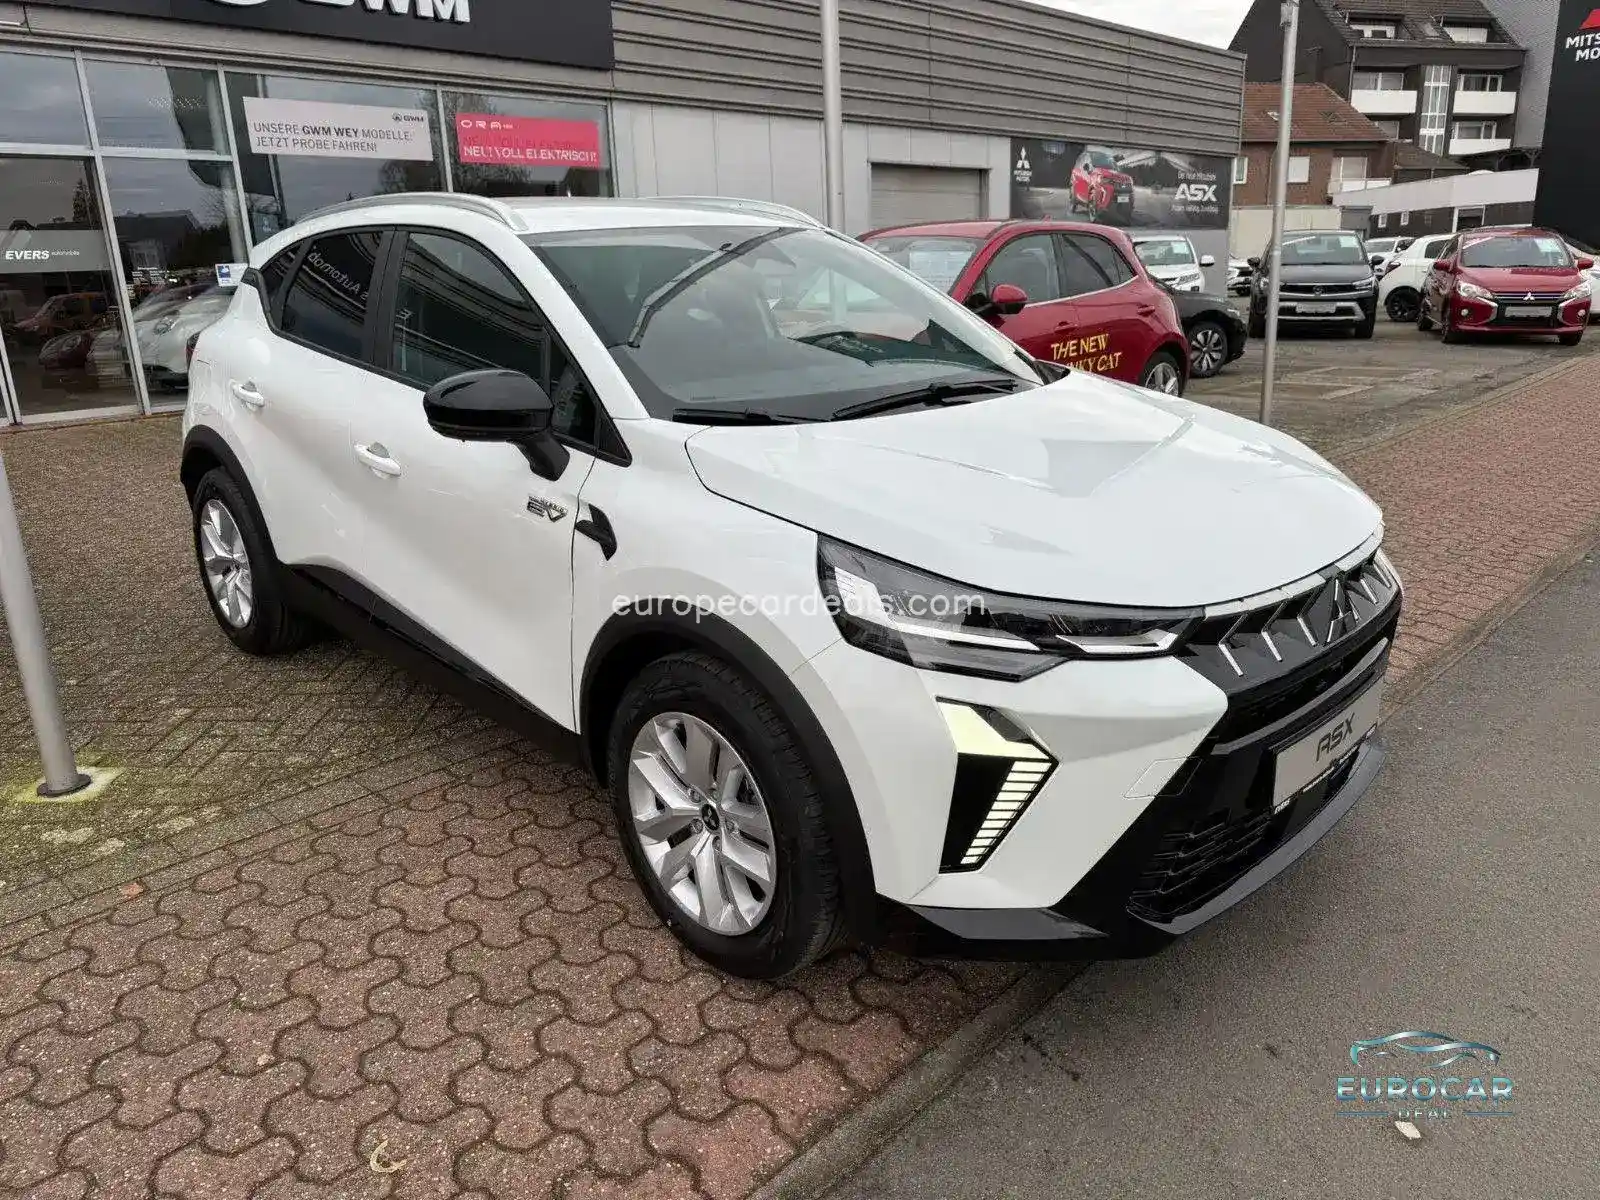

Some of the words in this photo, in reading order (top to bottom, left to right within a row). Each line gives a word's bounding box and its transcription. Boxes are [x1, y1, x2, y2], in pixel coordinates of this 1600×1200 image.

[1575, 47, 1600, 62] MO
[403, 114, 424, 123] GWM
[253, 122, 299, 135] UNSERE
[302, 126, 332, 137] GWM
[335, 127, 359, 138] WEY
[361, 128, 414, 142] MODELLE:
[256, 136, 289, 148] JETZT
[1174, 183, 1218, 202] ASX
[5, 250, 50, 260] EVERS
[1050, 340, 1078, 361] THE
[1079, 333, 1109, 355] NEW
[1097, 352, 1122, 371] CAT
[1315, 712, 1356, 762] ASX
